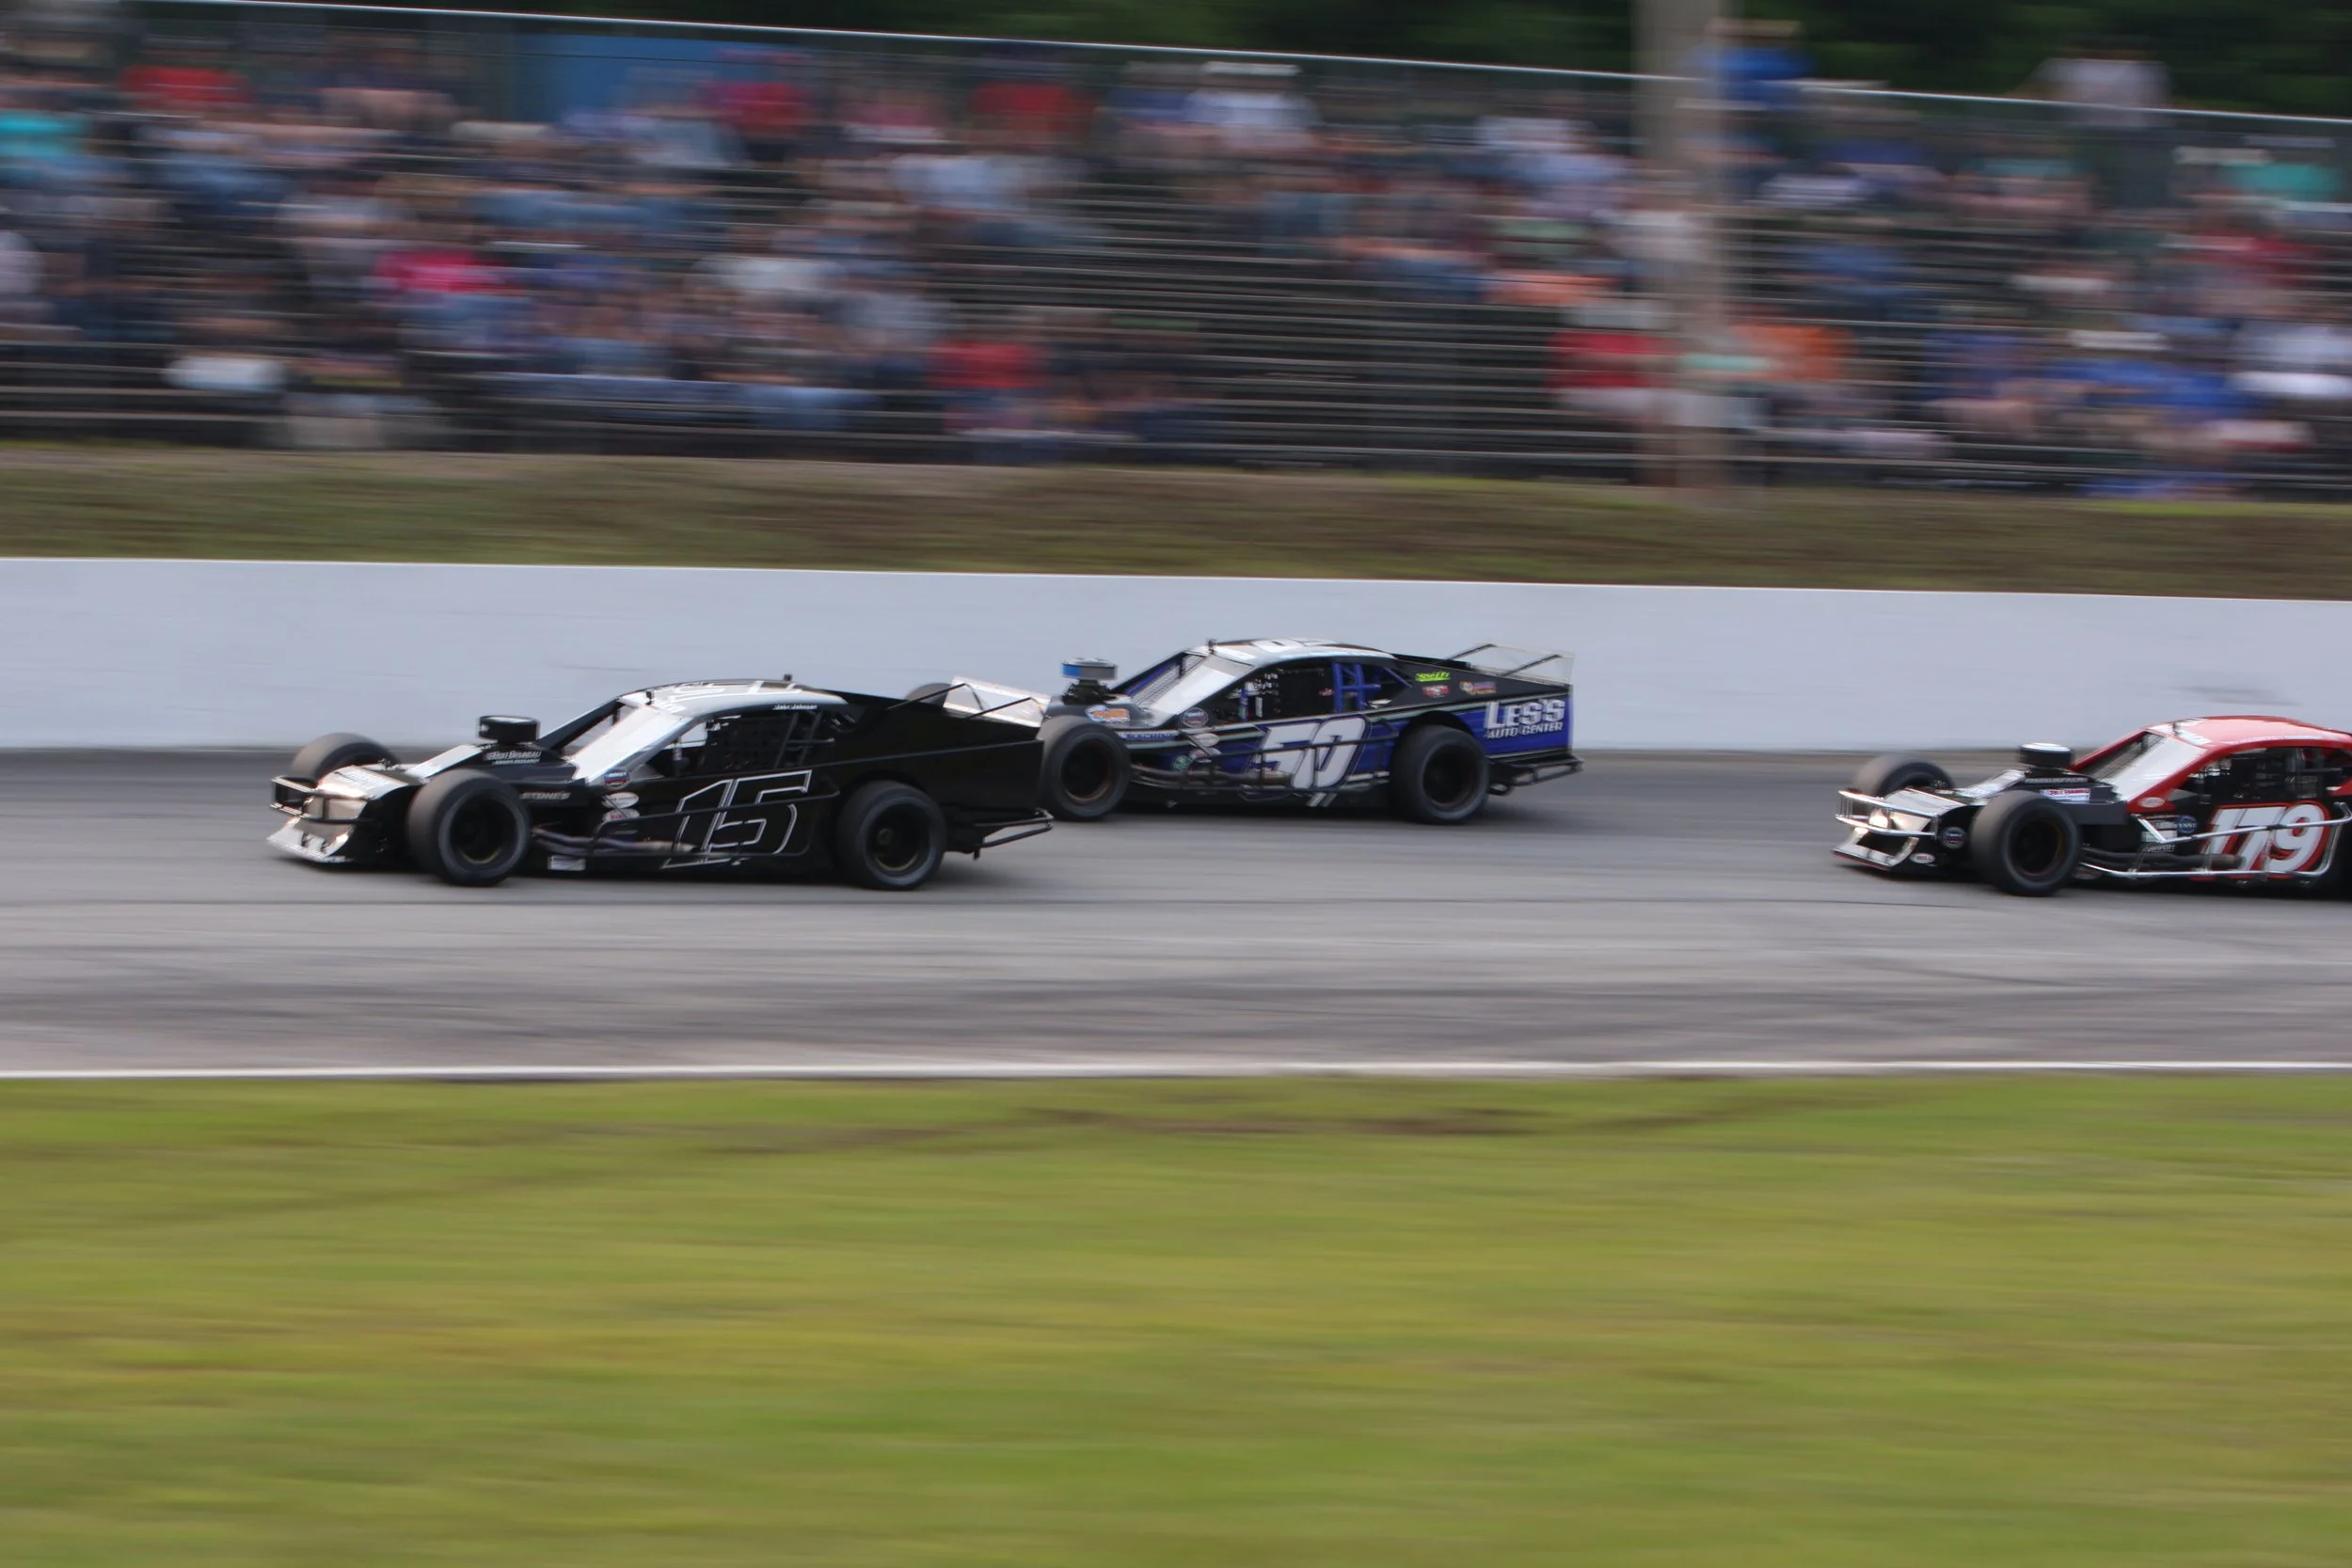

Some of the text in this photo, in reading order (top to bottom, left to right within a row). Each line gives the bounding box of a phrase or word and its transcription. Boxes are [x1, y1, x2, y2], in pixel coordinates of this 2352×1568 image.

[1485, 721, 1564, 738] AUTO CENTER
[661, 769, 813, 869] 15
